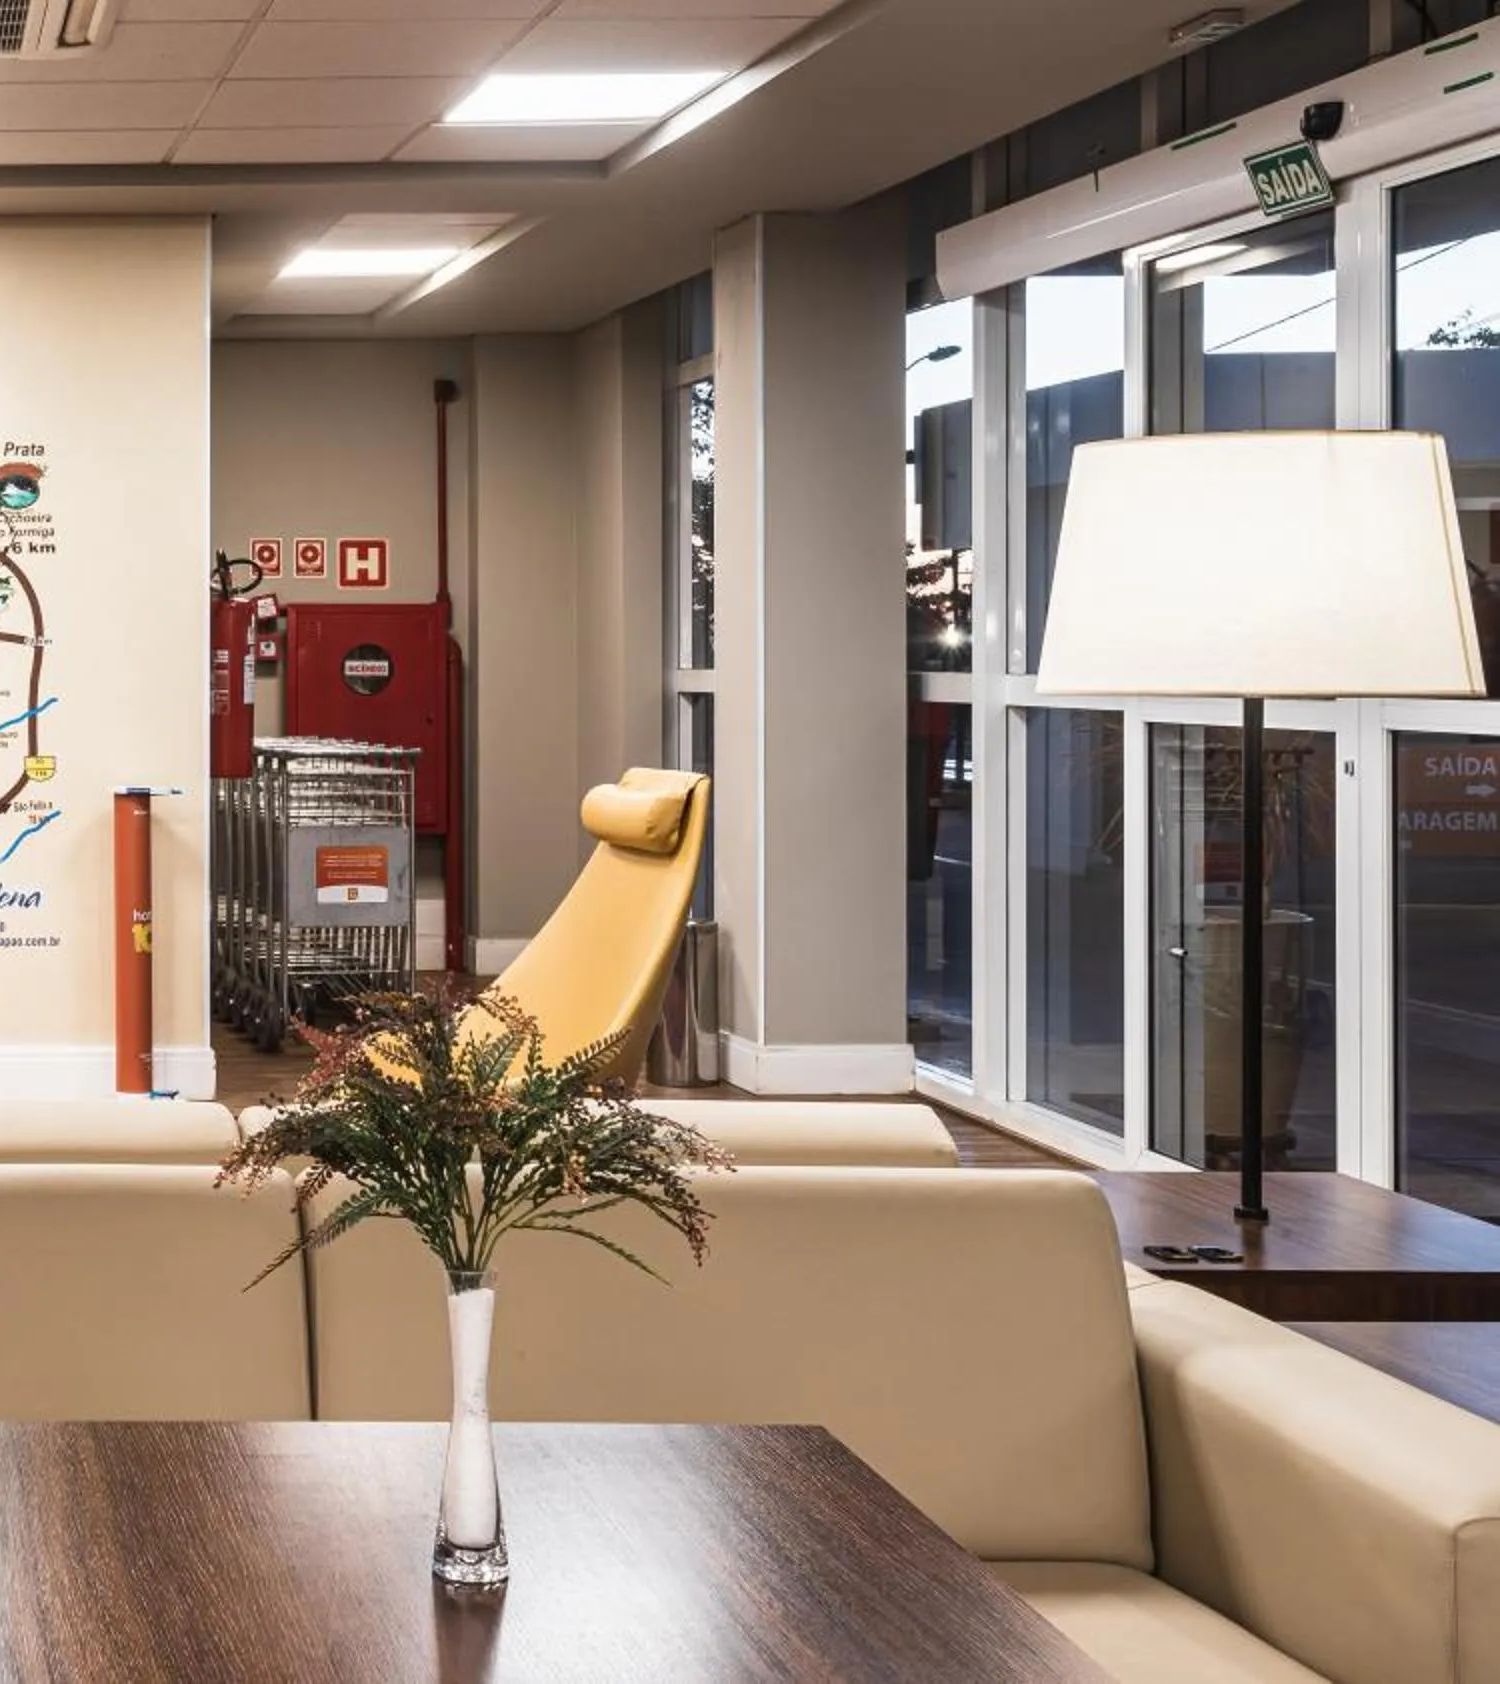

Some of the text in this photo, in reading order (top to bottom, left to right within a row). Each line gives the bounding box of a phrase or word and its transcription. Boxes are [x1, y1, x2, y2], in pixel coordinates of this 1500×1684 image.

[1257, 157, 1325, 205] SAÍDA
[3, 442, 46, 457] Prata
[28, 542, 56, 554] km
[346, 547, 380, 581] H
[1423, 753, 1498, 778] SAÍDA
[1397, 810, 1498, 832] ARAGEM
